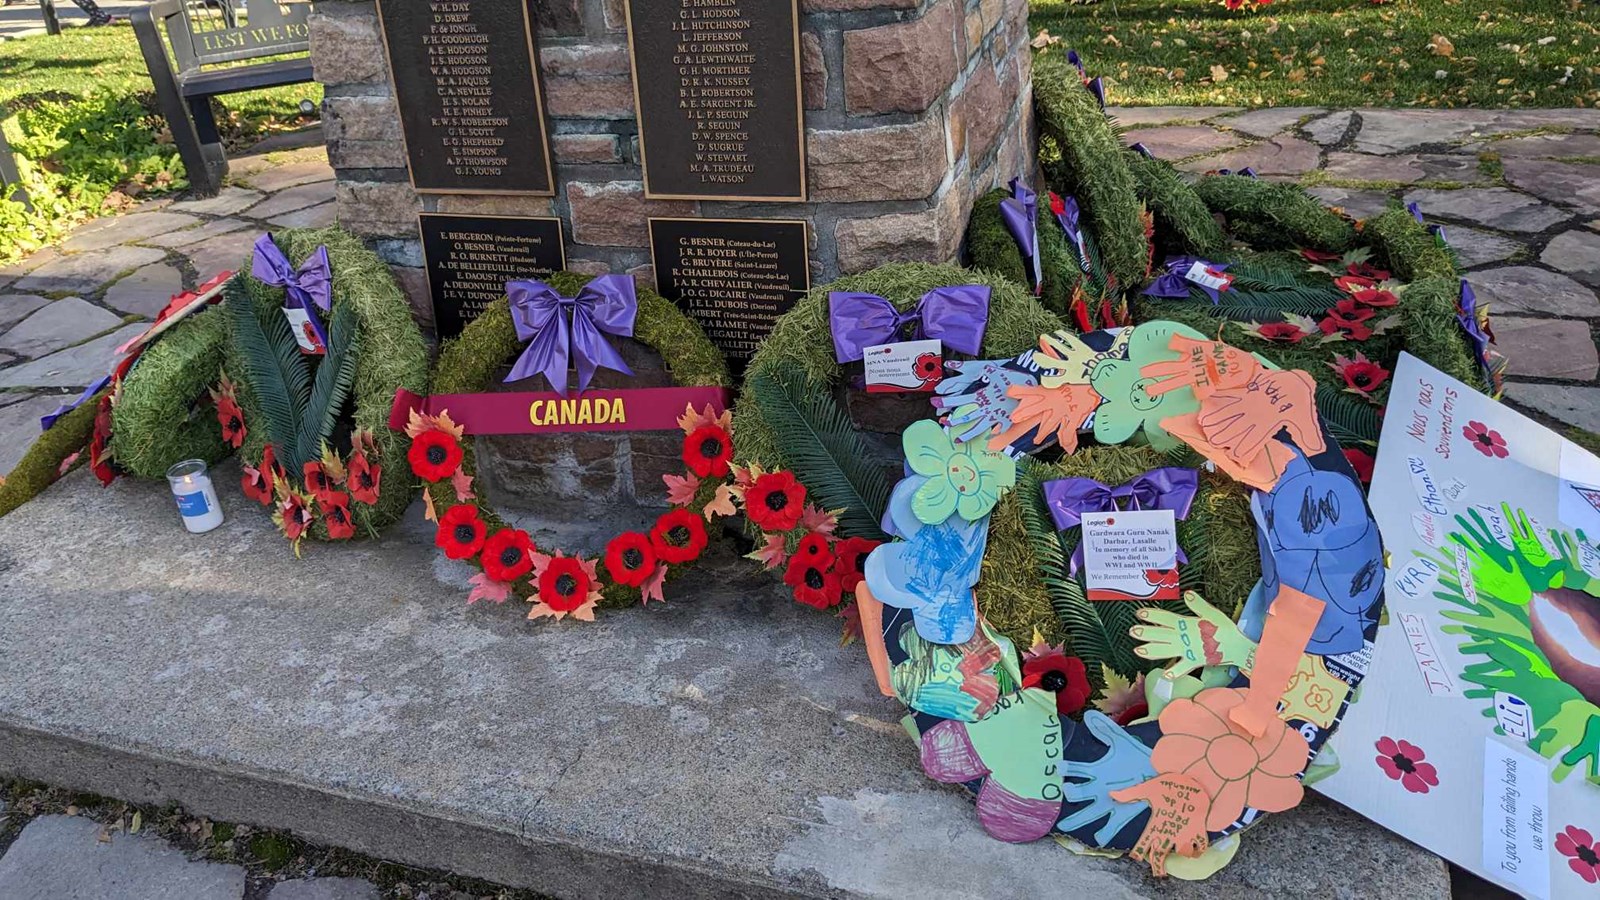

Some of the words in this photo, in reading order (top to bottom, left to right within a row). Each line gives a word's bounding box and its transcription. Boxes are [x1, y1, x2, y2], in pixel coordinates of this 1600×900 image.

[452, 3, 470, 11] DAY
[444, 14, 469, 22] DREW
[702, 9, 740, 18] HODSON
[691, 20, 750, 30] HUTCHINSON
[251, 26, 284, 42] WE
[286, 24, 308, 39] FO
[693, 32, 741, 41] JEFFERSON
[441, 35, 488, 43] GOODHUGH
[448, 46, 487, 54] HODGSON
[702, 44, 748, 52] JOHNSTON
[448, 56, 487, 65] HODGSON
[695, 55, 756, 63] LEWTHWAITE
[452, 66, 491, 75] HODGSON
[702, 66, 750, 74] MORTIMER
[458, 77, 489, 86] JAQUES
[715, 77, 749, 85] NUSSEY
[701, 88, 753, 96] ROBERTSON
[461, 98, 490, 106] NOLAN
[700, 99, 742, 107] SARGENT
[744, 99, 756, 107] JR.
[716, 110, 748, 119] SEGUIN
[461, 117, 508, 126] ROBERTSON
[708, 121, 740, 129] SEGUIN
[715, 132, 748, 140] SPENCE
[708, 143, 744, 151] SUGRUE
[465, 157, 507, 165] THOMPSON
[707, 153, 747, 162] STEWART
[473, 167, 501, 175] YOUNG
[712, 164, 754, 172] TRUDEAU
[708, 174, 744, 183] WATSON
[449, 232, 493, 241] BERGERON
[691, 238, 725, 246] BESNER
[465, 243, 495, 252] BESNER
[680, 248, 685, 256] J.
[470, 253, 508, 262] BURNETT
[460, 262, 515, 272] BELLEFEUILLE
[693, 258, 732, 267] BRUYÈRE
[465, 273, 497, 281] DAOUST
[683, 269, 738, 278] CHARLEBOIS
[452, 282, 503, 290] DEBONVILLE
[674, 279, 680, 287] J.
[701, 280, 752, 288] CHEVALIER
[681, 289, 686, 297] J.
[709, 290, 746, 299] DICAIRE
[690, 299, 695, 308] J.
[715, 301, 748, 309] DUBOIS
[686, 309, 721, 318] AMBERT
[530, 398, 626, 426] CANADA
[1406, 410, 1428, 444] Nous
[1418, 378, 1434, 409] nous
[1476, 504, 1506, 540] Noah
[1396, 558, 1438, 597] KYRA
[1400, 613, 1451, 694] JAMES
[1326, 660, 1340, 672] Item
[1340, 668, 1360, 682] weight
[1042, 714, 1060, 800] Oscar
[1500, 758, 1517, 787] hands
[1500, 787, 1520, 816] failing
[1527, 804, 1543, 834] throw
[1500, 816, 1516, 840] from
[1532, 835, 1543, 851] we
[1506, 840, 1521, 864] you
[1500, 862, 1516, 874] To
